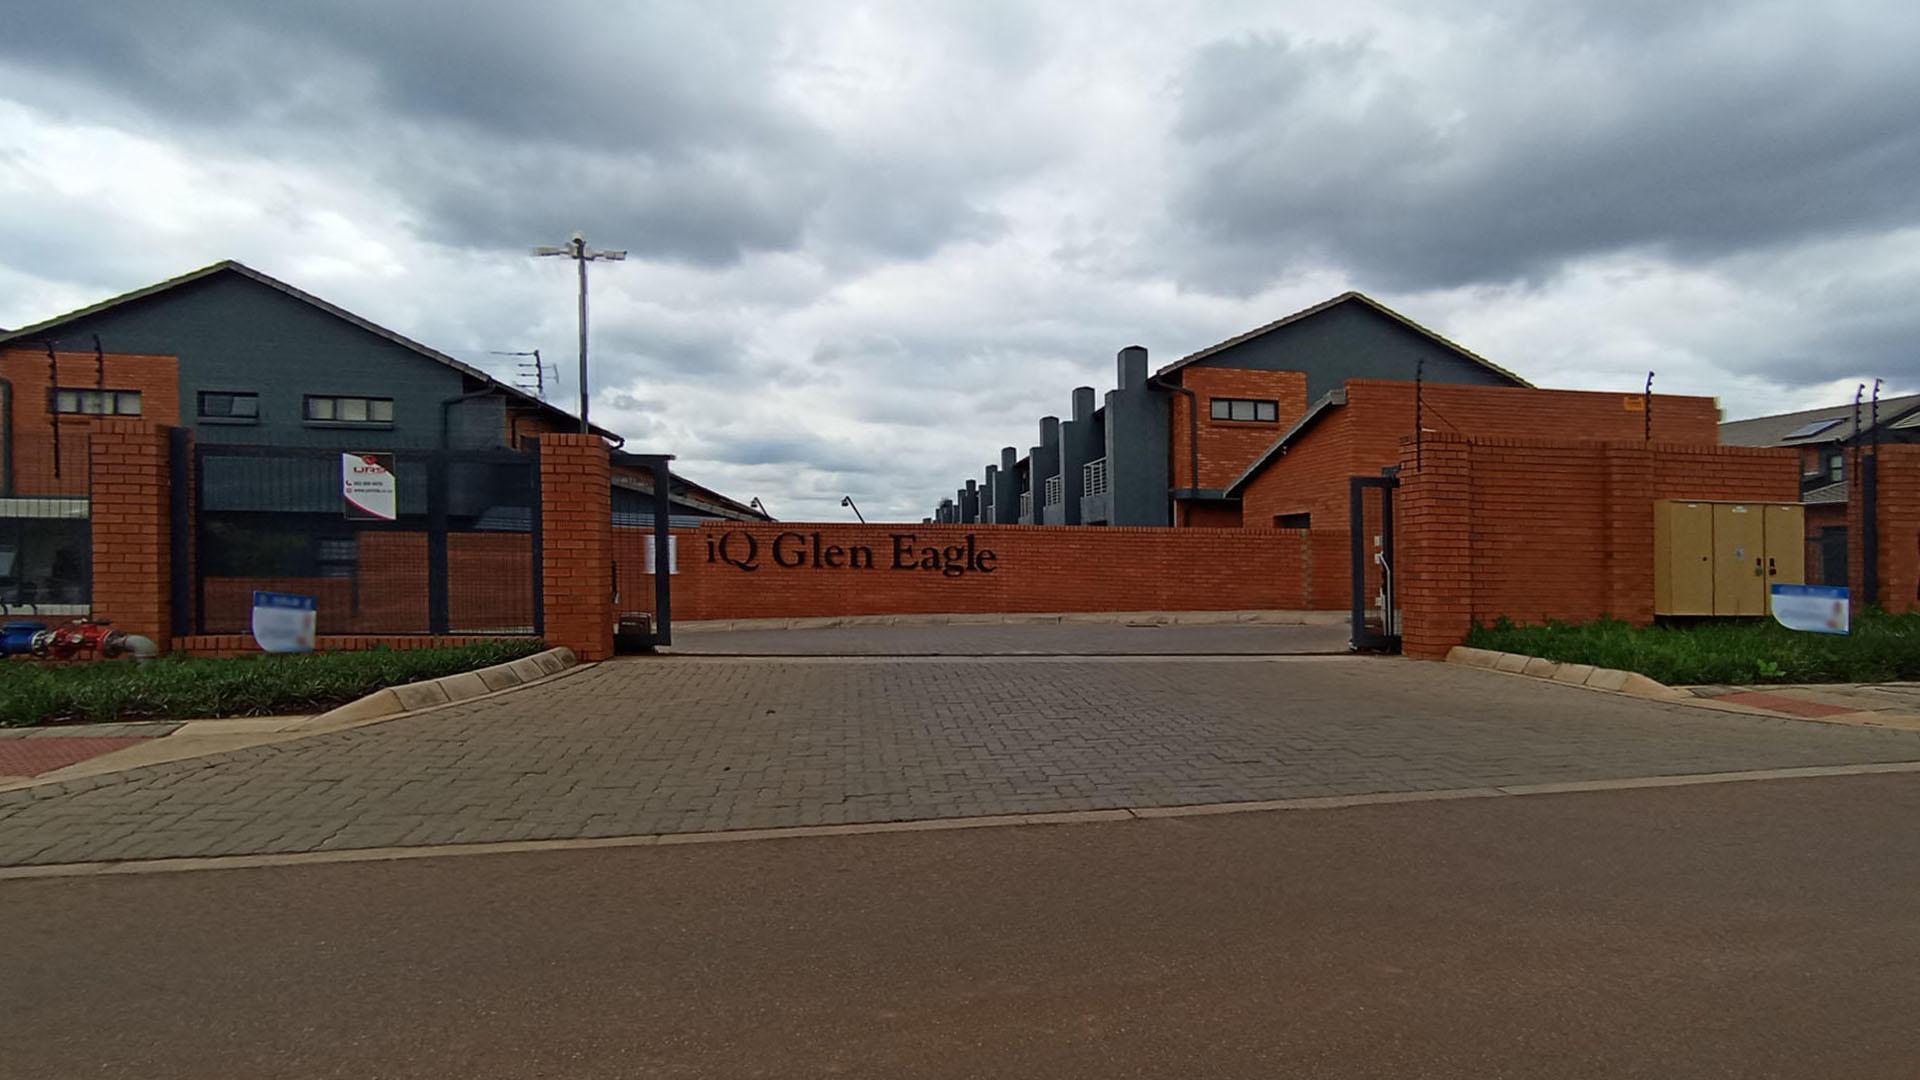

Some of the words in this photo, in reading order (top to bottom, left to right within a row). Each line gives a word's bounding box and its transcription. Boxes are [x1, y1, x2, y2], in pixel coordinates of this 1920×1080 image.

[706, 531, 759, 571] iQ
[772, 531, 875, 568] Glen
[890, 533, 998, 577] Eagle
